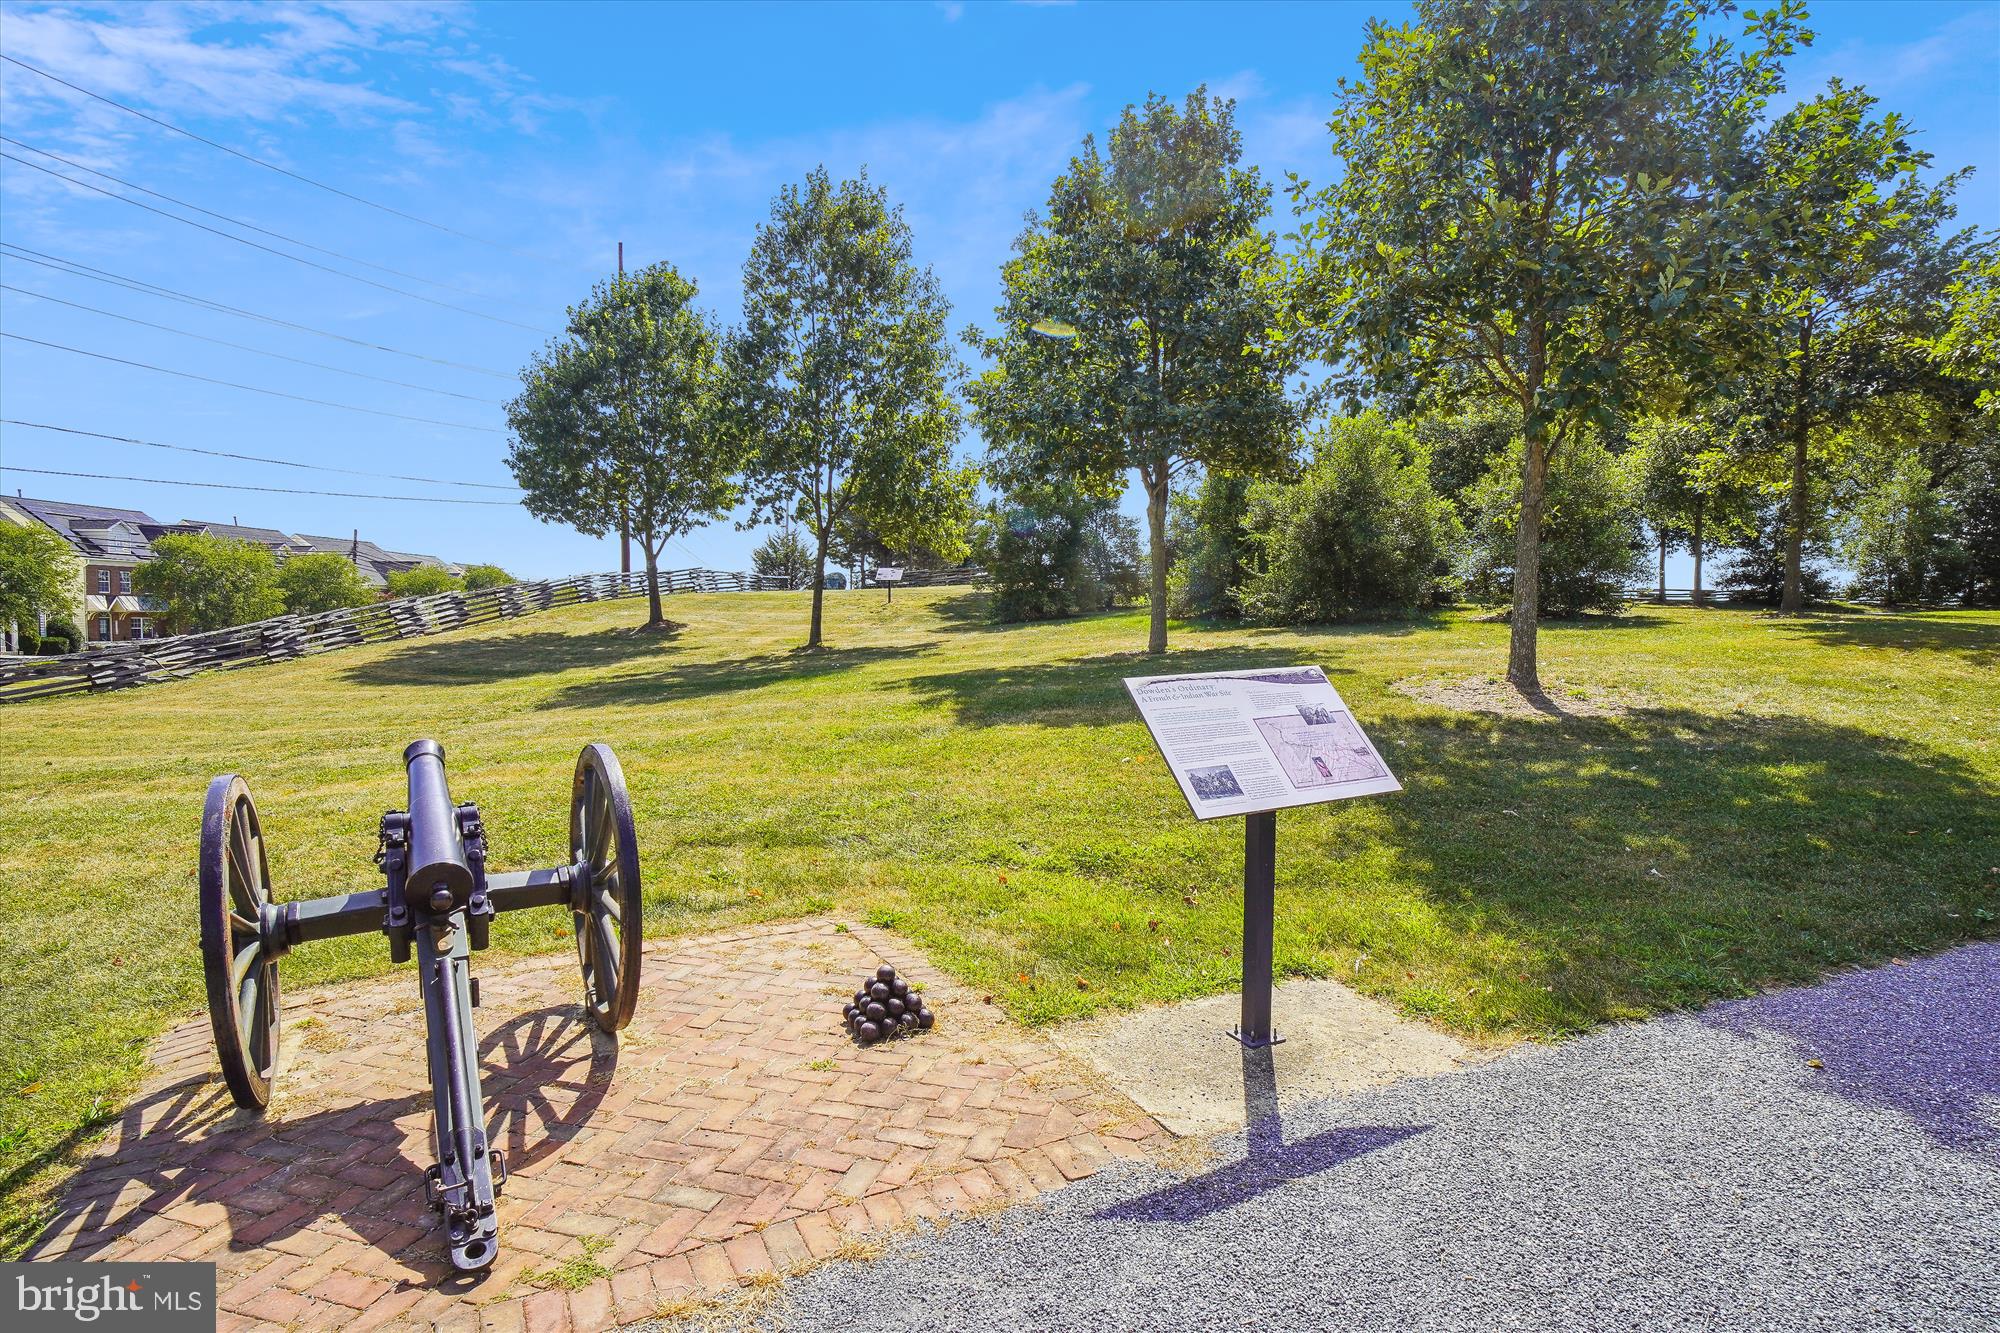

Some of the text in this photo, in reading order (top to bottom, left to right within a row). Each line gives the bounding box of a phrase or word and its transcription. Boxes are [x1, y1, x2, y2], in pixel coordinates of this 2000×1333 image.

[1136, 685, 1176, 695] Dowden's
[1148, 694, 1171, 702] French
[1180, 692, 1204, 700] Indian
